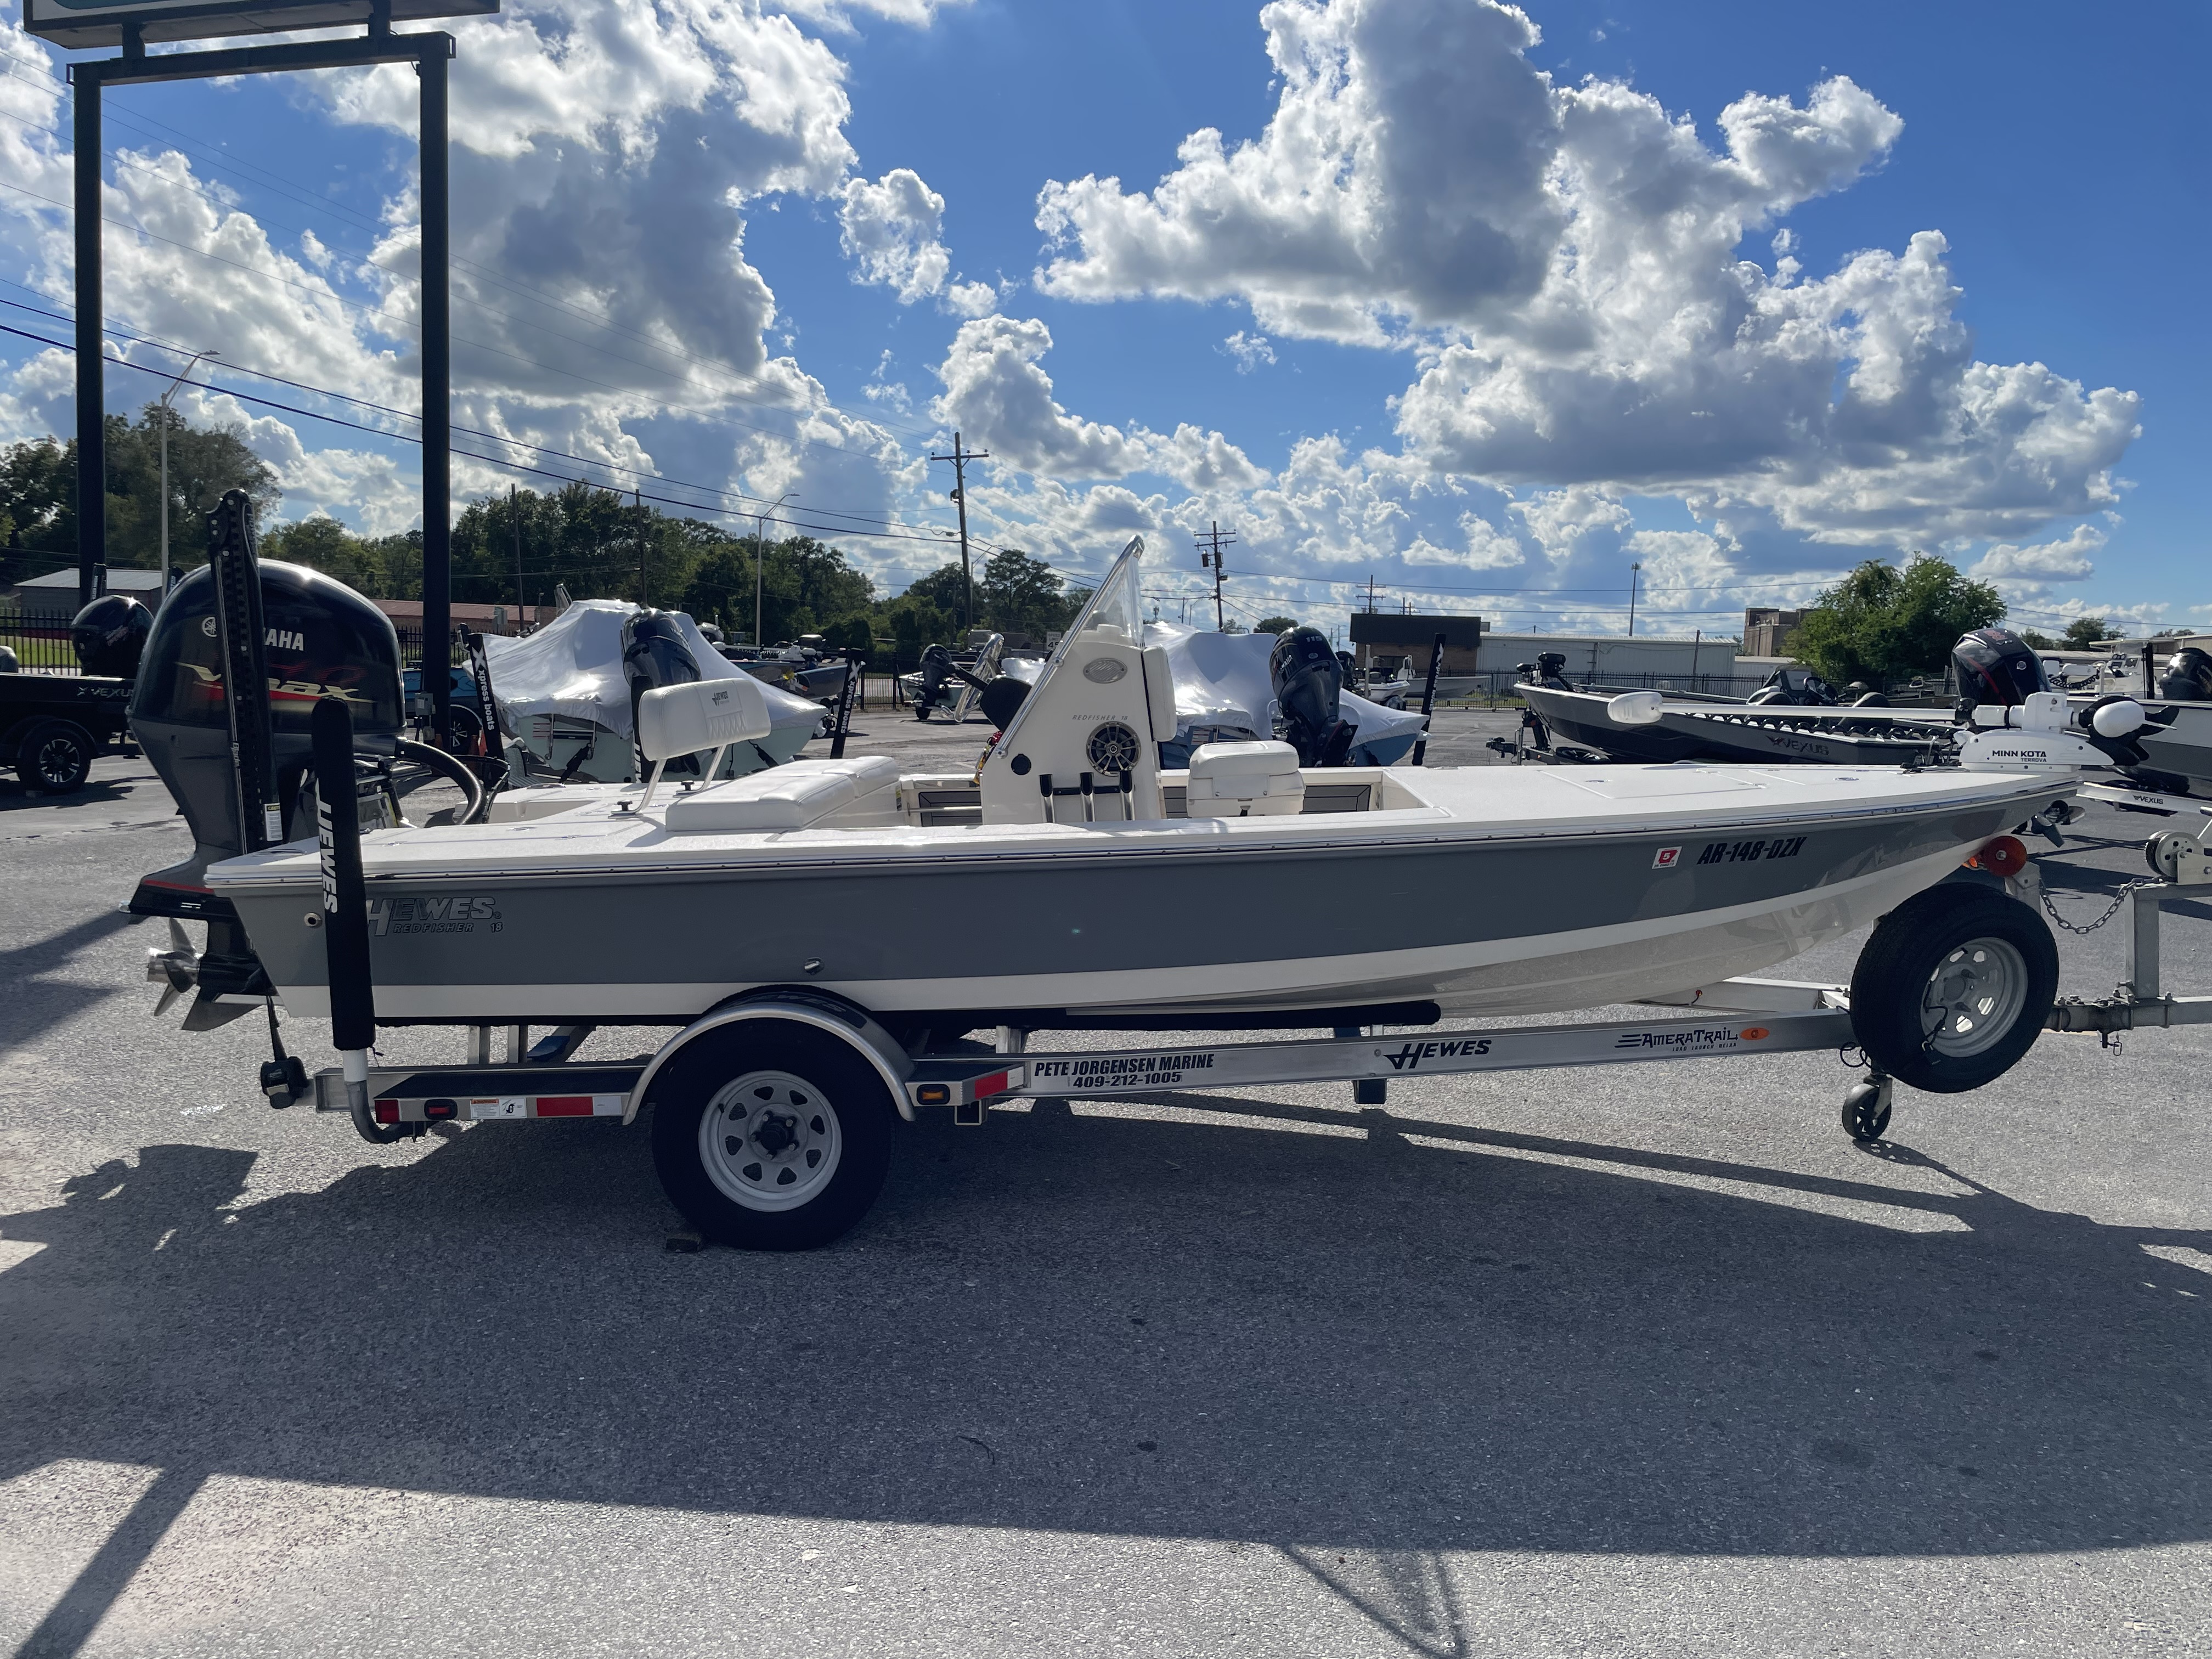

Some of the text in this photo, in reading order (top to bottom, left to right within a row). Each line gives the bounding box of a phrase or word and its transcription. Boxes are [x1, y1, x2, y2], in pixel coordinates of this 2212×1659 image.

[477, 669, 490, 702] xpress
[484, 703, 494, 731] boats
[845, 680, 856, 709] xpress
[840, 710, 850, 734] boats
[1782, 740, 1830, 755] VEXUS
[2140, 795, 2164, 805] VEXUS
[1662, 852, 1671, 861] 5
[1696, 836, 1808, 865] AR-148-DZX
[393, 922, 504, 934] REDFISHER 18
[1034, 1053, 1215, 1076] PETE JORGENSEN MARINE
[1383, 1040, 1492, 1070] HEWES
[1073, 1071, 1181, 1088] 409-212-1005
